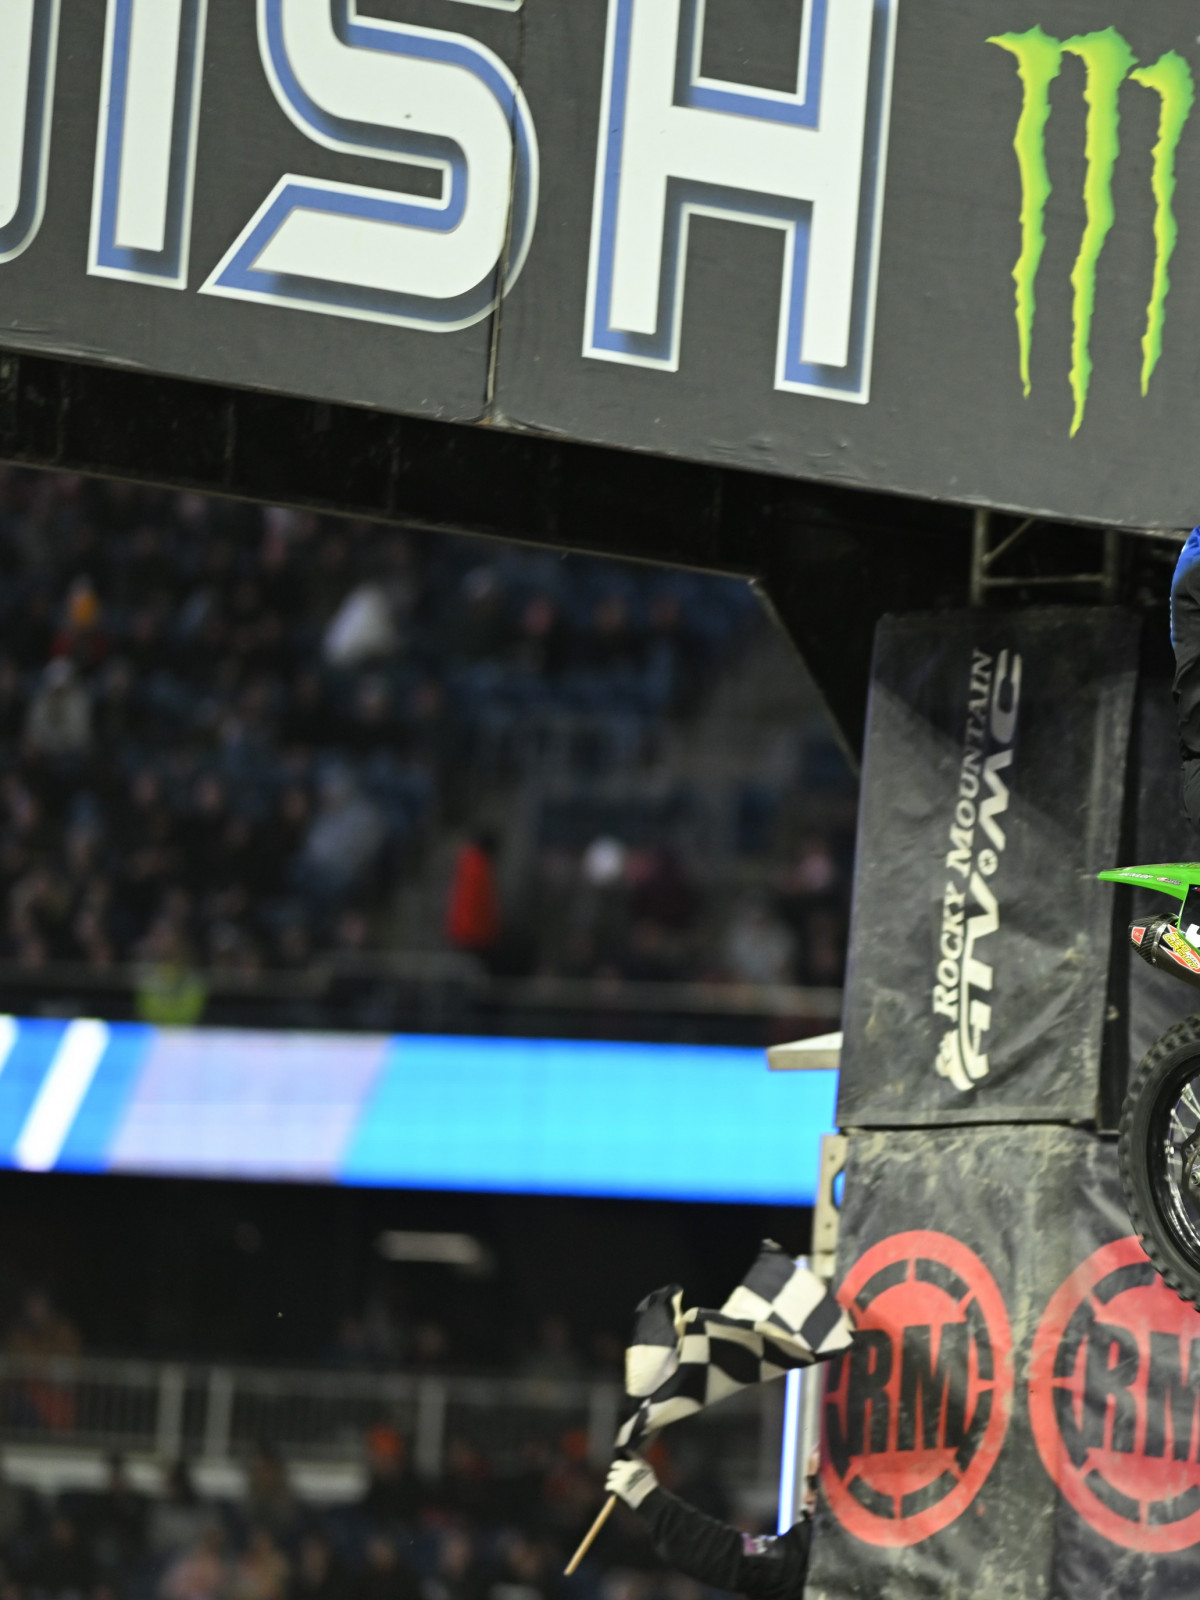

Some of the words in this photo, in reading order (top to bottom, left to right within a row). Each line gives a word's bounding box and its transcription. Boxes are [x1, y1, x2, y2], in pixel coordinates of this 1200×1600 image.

[0, 0, 893, 404] ISH
[946, 648, 994, 878] MOUNTAIN
[933, 882, 967, 1022] ROCKY
